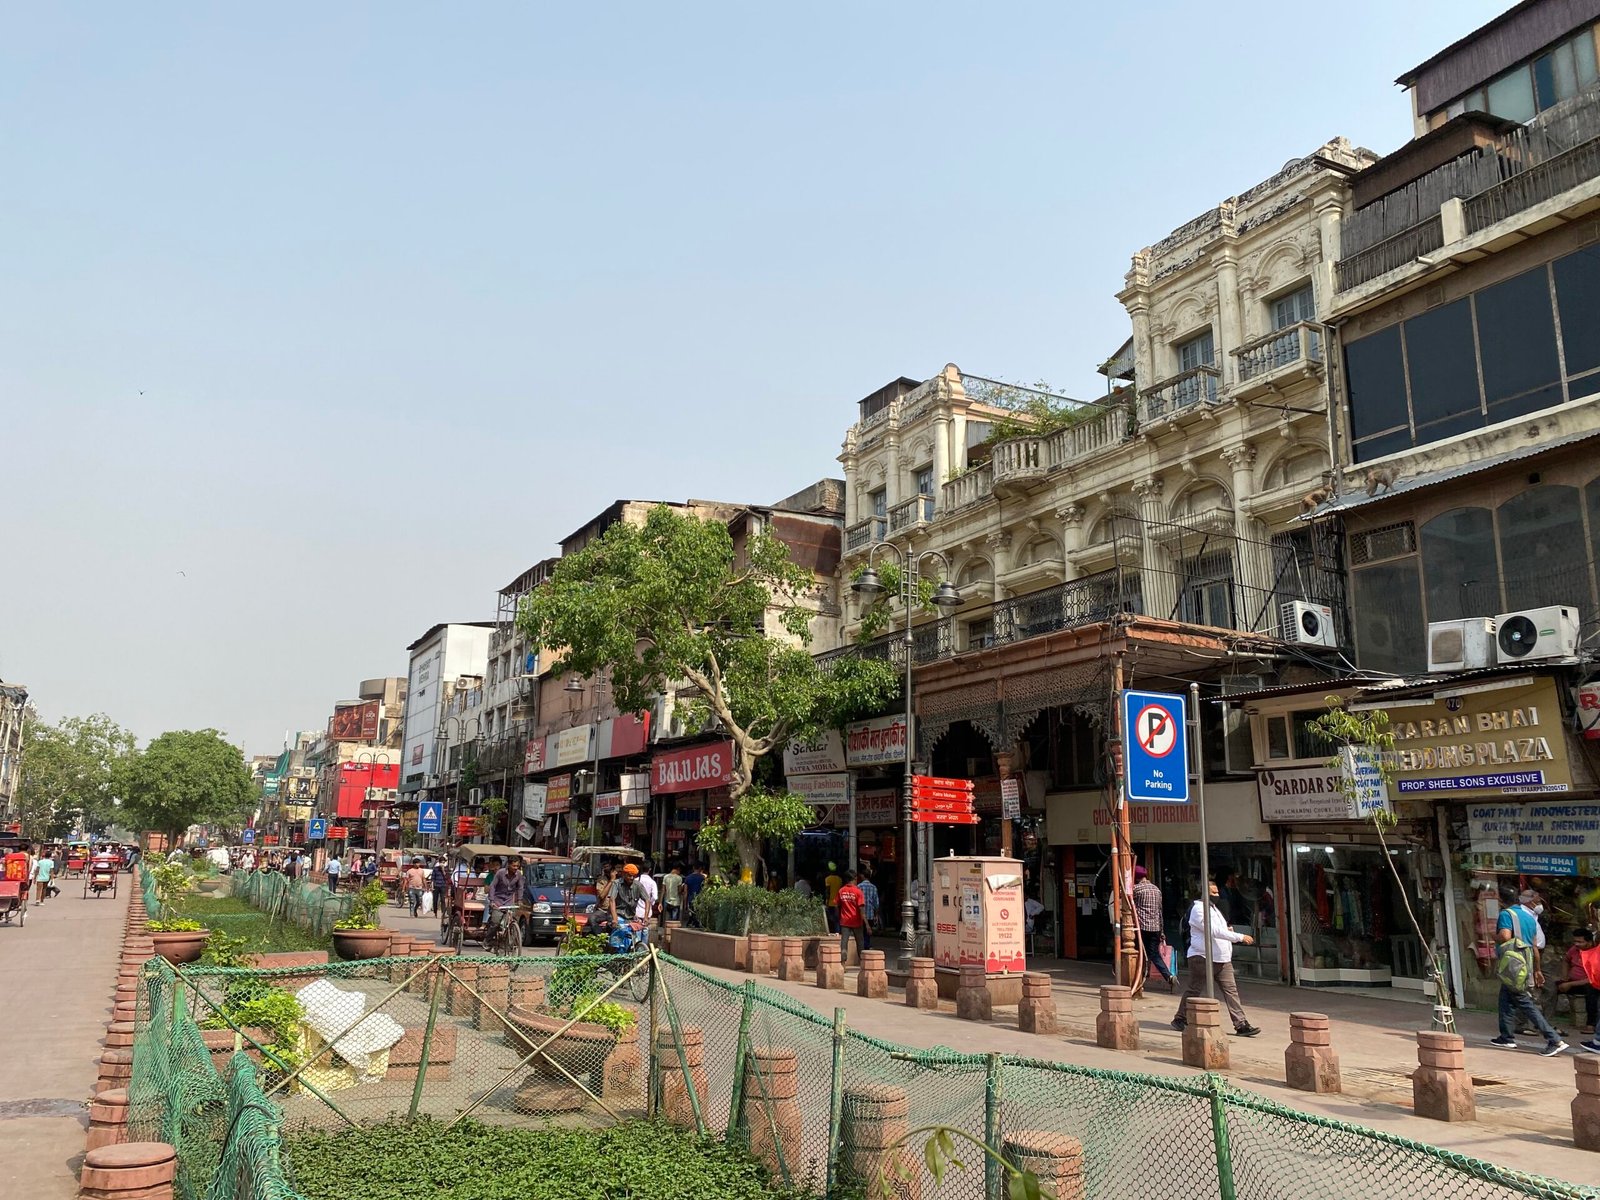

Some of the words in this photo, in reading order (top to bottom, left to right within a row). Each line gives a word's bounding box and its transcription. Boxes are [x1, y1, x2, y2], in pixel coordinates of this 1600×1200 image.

[1391, 716, 1470, 740] KARAN
[1476, 706, 1539, 732] BHAI
[1474, 737, 1553, 766] PLAZA
[659, 753, 721, 785] BALUJAS
[811, 763, 838, 771] MOHAN
[1153, 769, 1163, 778] No
[814, 779, 845, 789] Fashions
[1145, 780, 1172, 791] Parking
[1274, 777, 1325, 795] SARDAR
[1401, 781, 1427, 791] PROP.
[1428, 779, 1457, 789] SHEEL
[1459, 776, 1485, 787] SONS
[1473, 808, 1496, 818] COAT
[1498, 807, 1523, 817] PANT
[1537, 834, 1585, 845] TAILORING
[1552, 857, 1574, 866] BHAI
[937, 923, 957, 932] BSES
